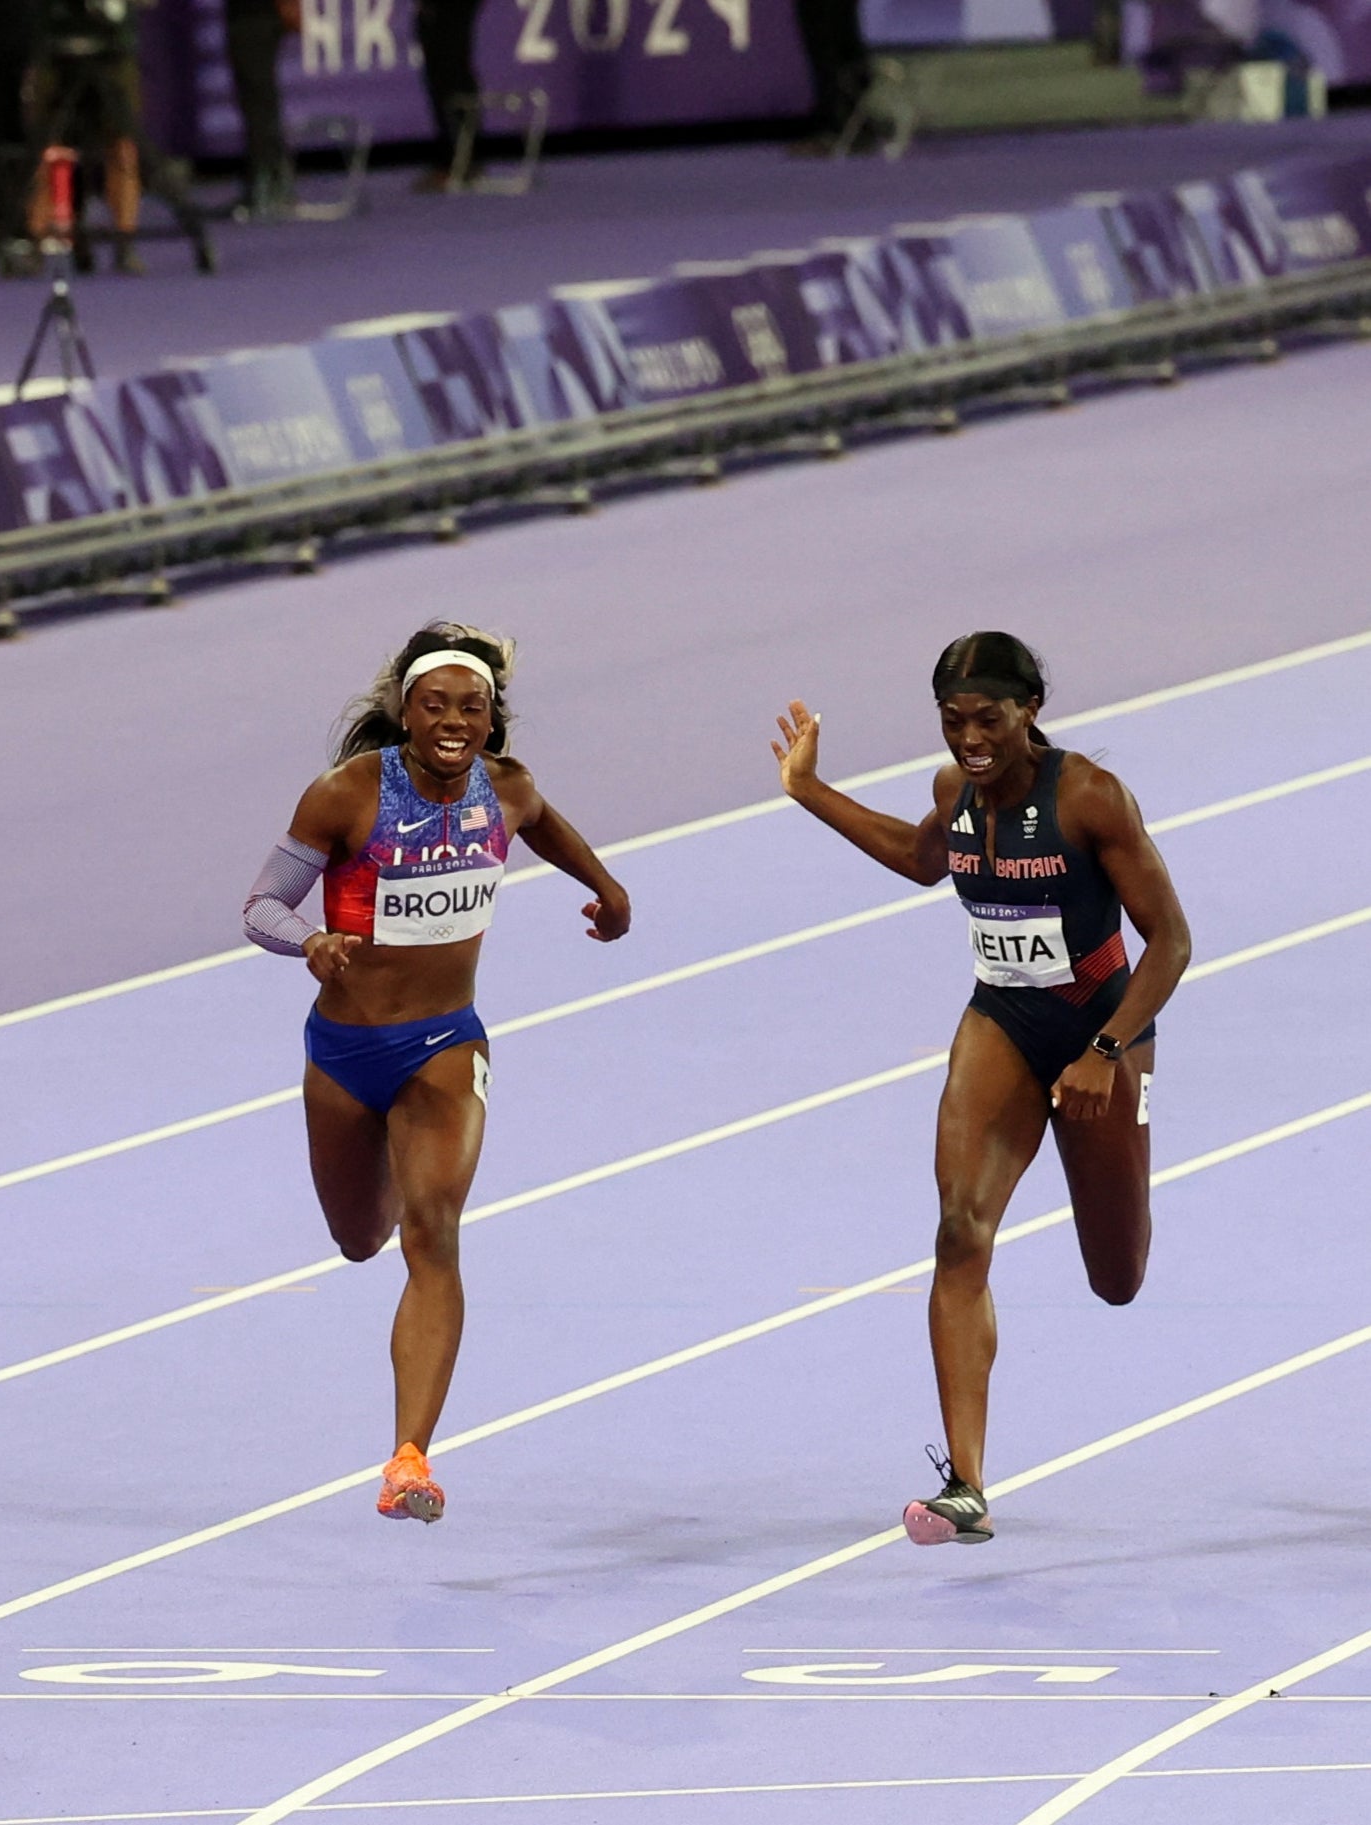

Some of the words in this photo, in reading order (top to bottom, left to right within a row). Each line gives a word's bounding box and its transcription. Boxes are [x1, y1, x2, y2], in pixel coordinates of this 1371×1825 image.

[412, 863, 443, 874] PARIS
[445, 859, 474, 870] 2024
[995, 854, 1067, 880] BRITAIN
[383, 881, 497, 918] BROWN
[998, 907, 1027, 918] 2024
[18, 1660, 387, 1685] 6
[741, 1662, 1120, 1685] 5
